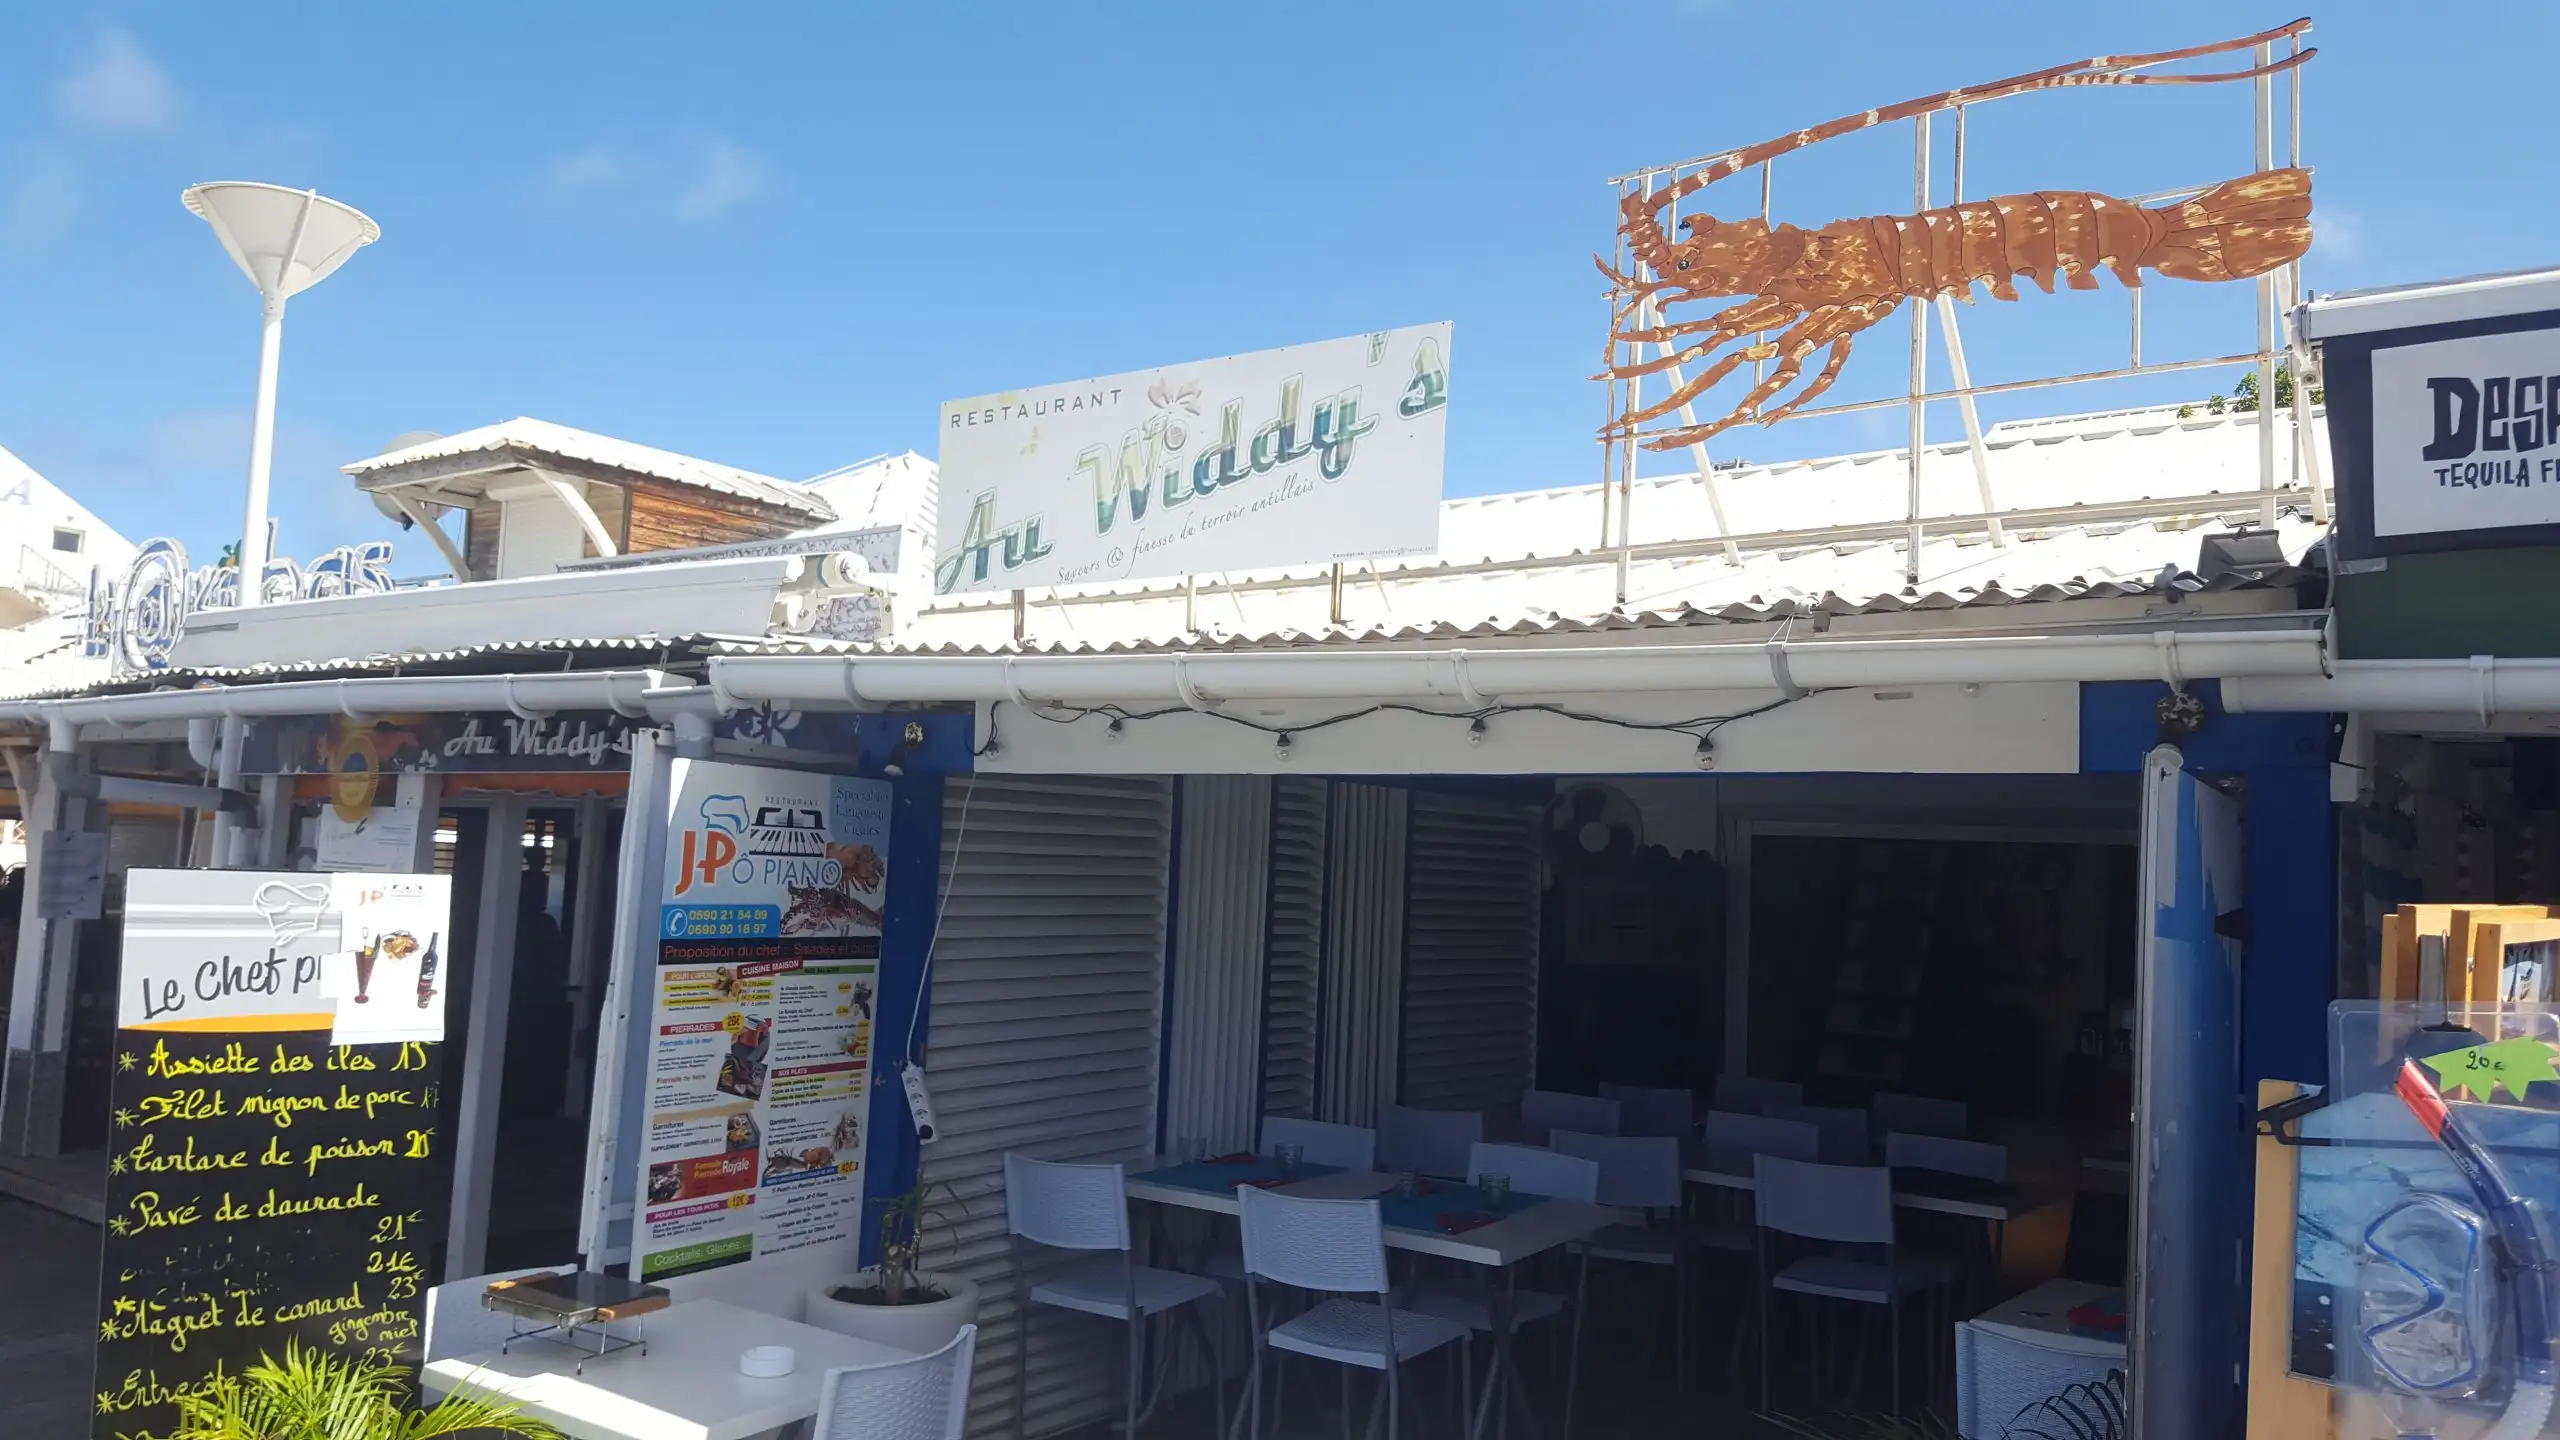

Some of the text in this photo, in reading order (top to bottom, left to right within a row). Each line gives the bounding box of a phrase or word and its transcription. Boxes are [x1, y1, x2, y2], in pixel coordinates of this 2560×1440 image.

[951, 388, 1122, 429] RESTAURANT
[934, 330, 1447, 595] Au Widdy's
[2433, 458, 2530, 489] TEQUILA
[1056, 559, 1101, 585] Saveurs
[1120, 527, 1176, 580] finesse
[1180, 511, 1197, 539] du
[1200, 503, 1246, 532] terroir
[1251, 472, 1315, 514] antillais
[443, 714, 633, 766] Au Widdy's
[763, 858, 842, 886] PIANO
[720, 910, 733, 920] 21
[664, 945, 735, 960] Proposition
[738, 945, 753, 956] du
[756, 944, 780, 956] chef
[794, 943, 836, 956] Salades
[741, 959, 800, 976] CUISINE MAISON
[143, 947, 321, 1020] Le Chef p
[670, 1023, 716, 1033] PIERRADES
[146, 1038, 260, 1080] Assiette
[269, 1043, 315, 1075] des
[140, 1088, 229, 1127] Filet
[237, 1087, 329, 1129] mignon
[334, 1084, 361, 1111] de
[366, 1085, 415, 1119] porc
[260, 1135, 294, 1167] de
[303, 1137, 397, 1178] poisson
[722, 1158, 750, 1176] Royale
[129, 1182, 382, 1237] Pavé de daurade
[365, 1251, 419, 1273] 21€
[121, 1297, 225, 1352] Magret
[235, 1296, 266, 1329] de
[275, 1281, 365, 1323] canard
[328, 1302, 413, 1345] gingembre
[378, 1320, 418, 1341] miel
